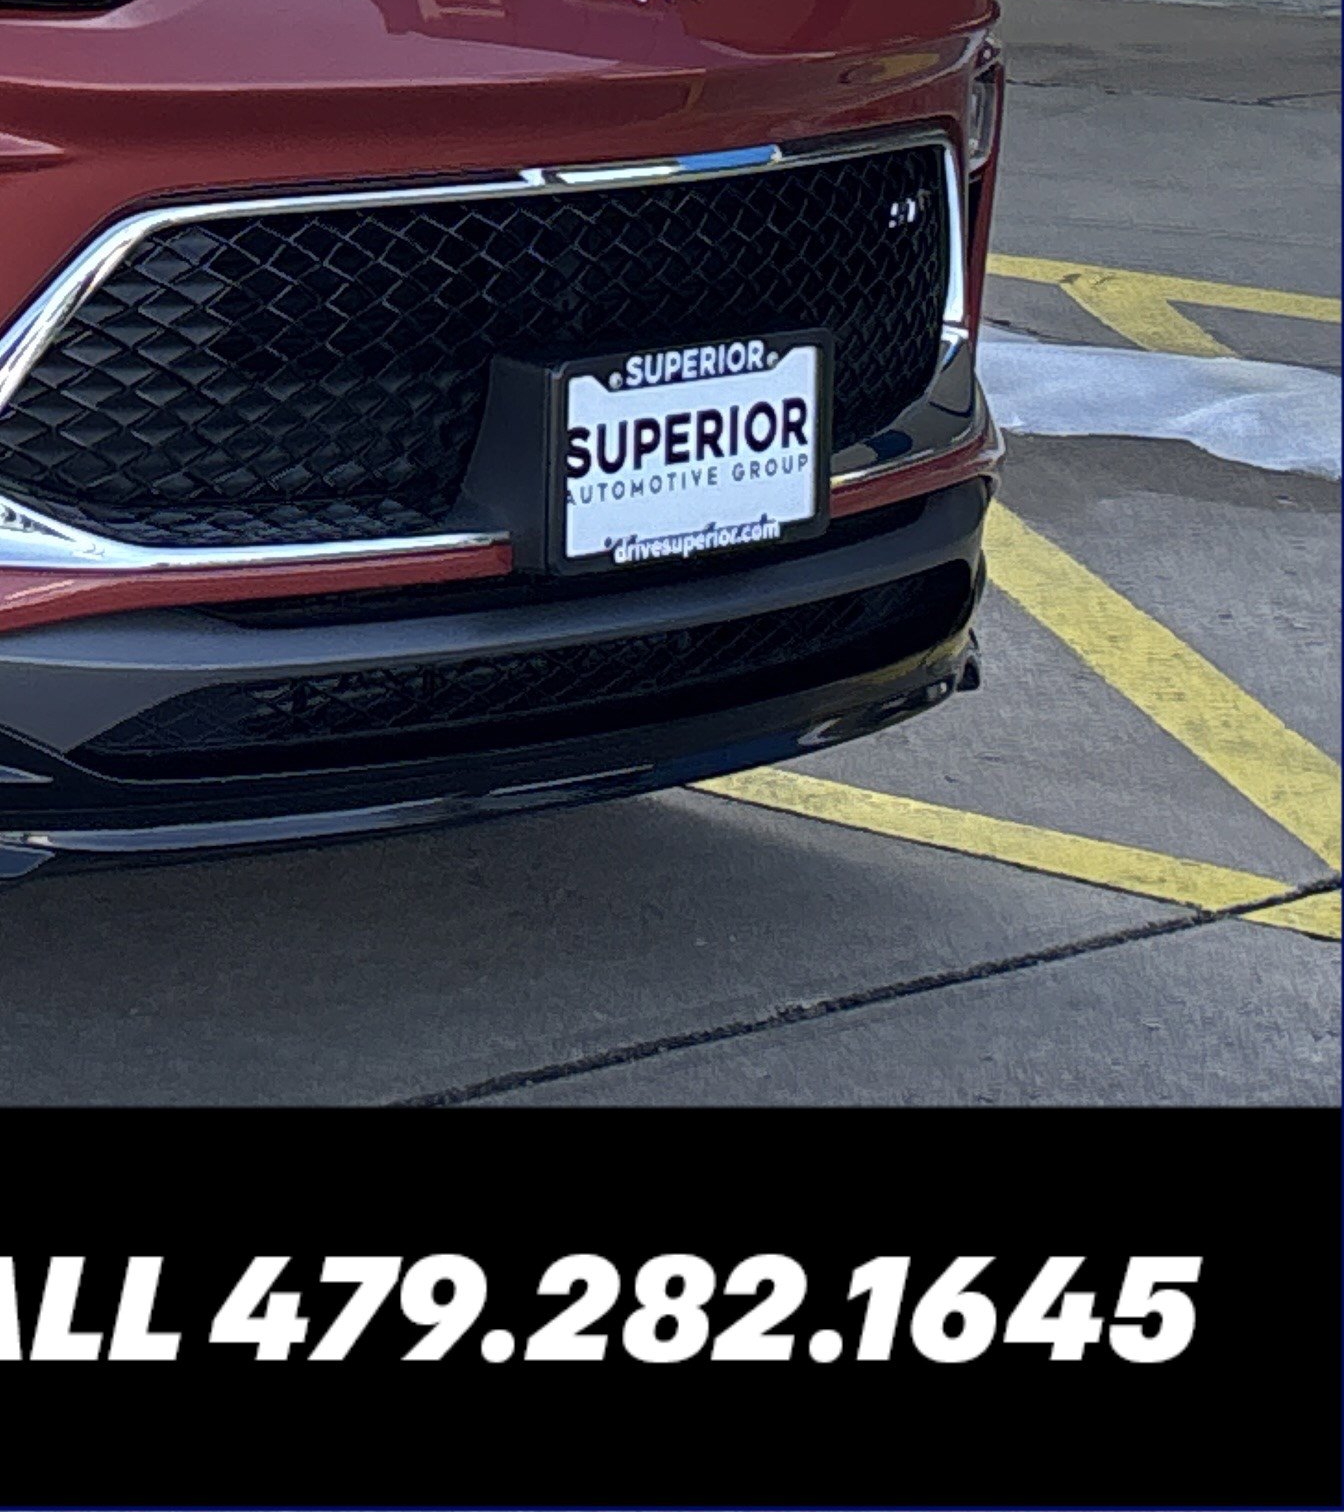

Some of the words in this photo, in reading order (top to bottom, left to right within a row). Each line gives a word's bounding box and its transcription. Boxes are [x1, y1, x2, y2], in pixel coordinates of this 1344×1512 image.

[625, 339, 766, 387] SUPERIOR
[565, 397, 809, 479] SUPERIOR
[565, 465, 719, 506] AUTOMOTIVE
[731, 453, 809, 483] GROUP
[614, 515, 781, 565] drivesuperior.com
